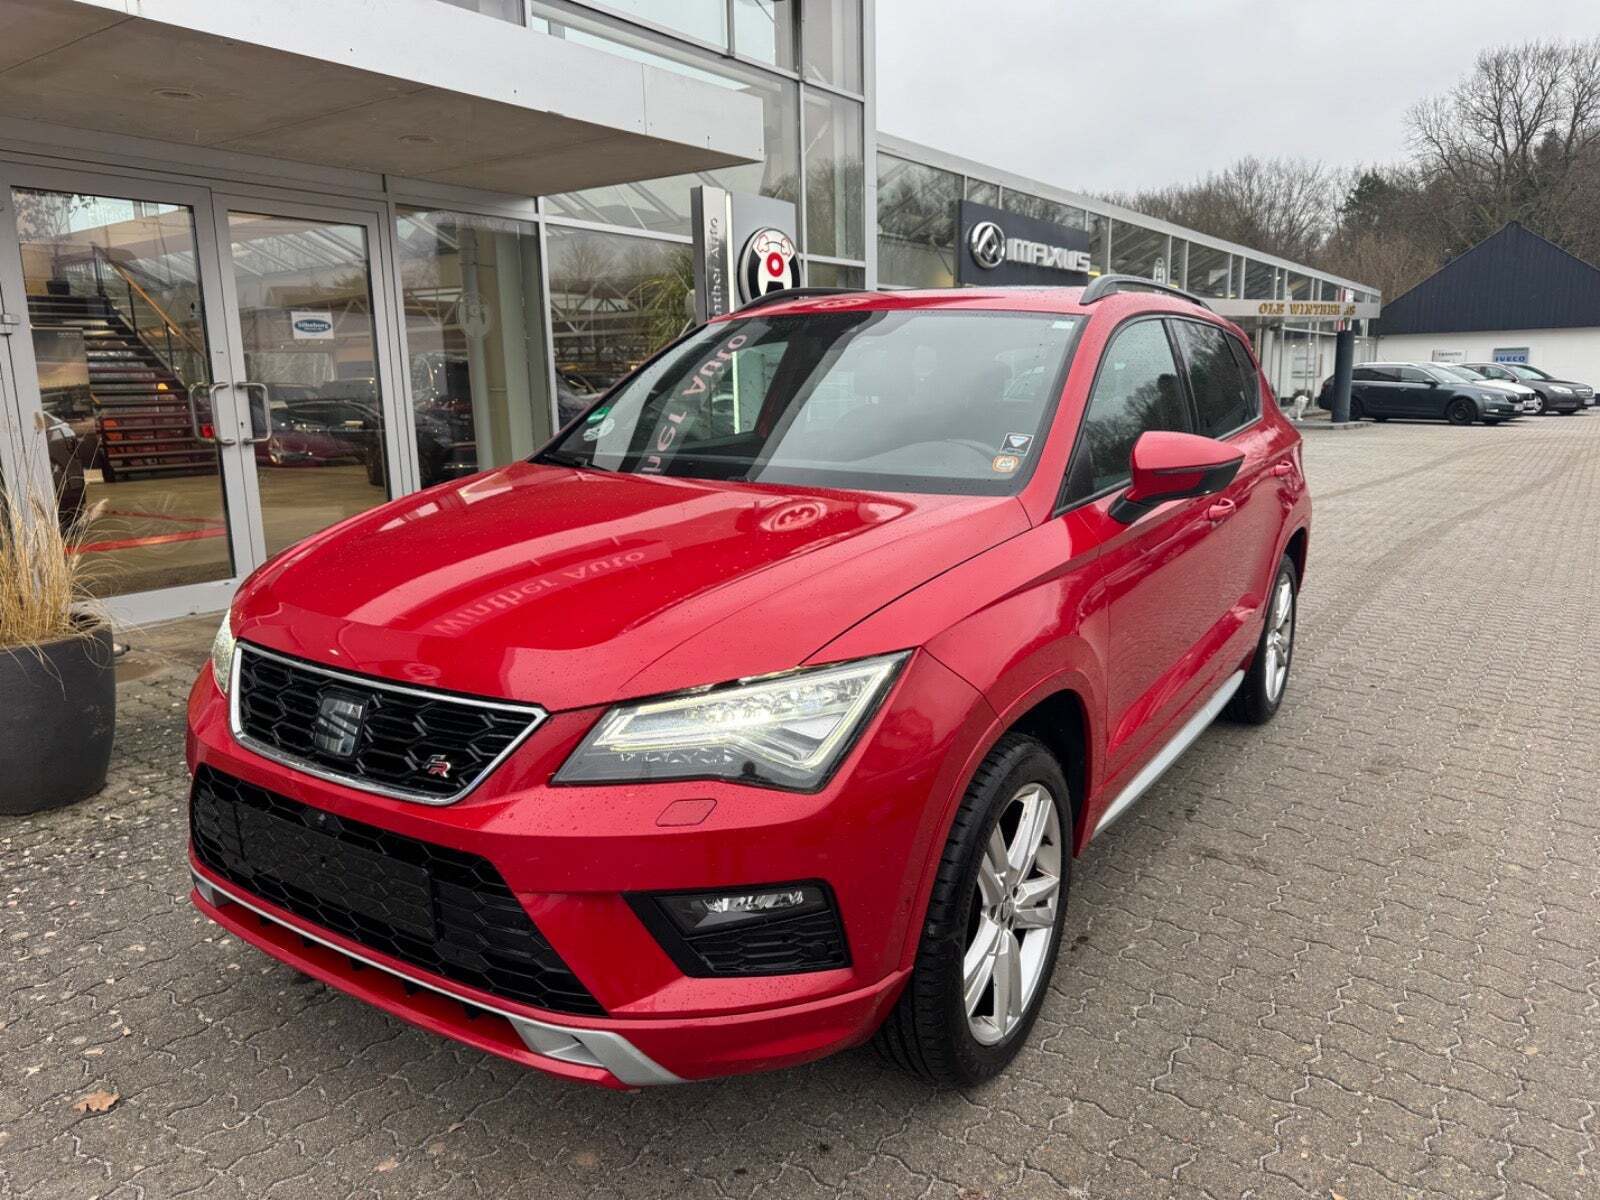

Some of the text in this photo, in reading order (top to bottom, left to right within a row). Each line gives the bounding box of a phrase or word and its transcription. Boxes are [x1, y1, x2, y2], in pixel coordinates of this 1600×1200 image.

[1006, 238, 1091, 272] MAXUS
[1258, 302, 1284, 315] OLE
[1495, 355, 1526, 363] IVECO
